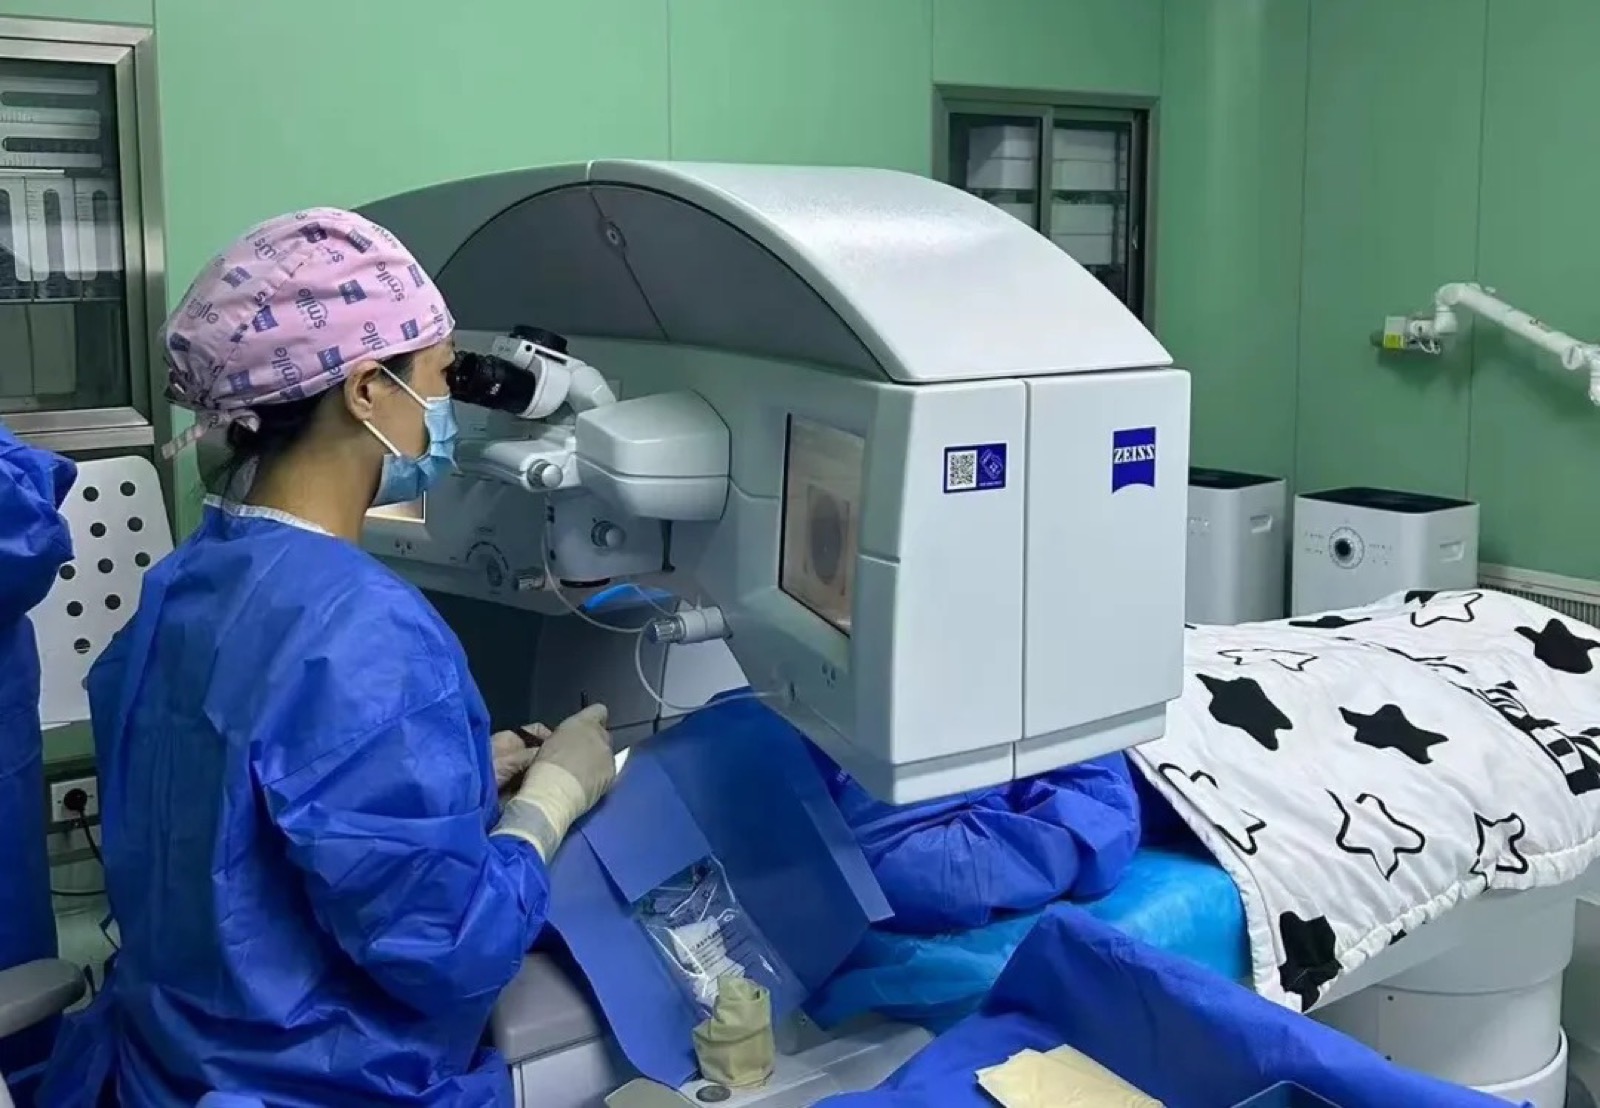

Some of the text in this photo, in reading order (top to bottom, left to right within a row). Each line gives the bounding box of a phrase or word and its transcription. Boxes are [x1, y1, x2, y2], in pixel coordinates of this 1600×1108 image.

[375, 261, 405, 302] smile
[296, 288, 329, 330] smile
[1114, 444, 1155, 464] ZEISS
